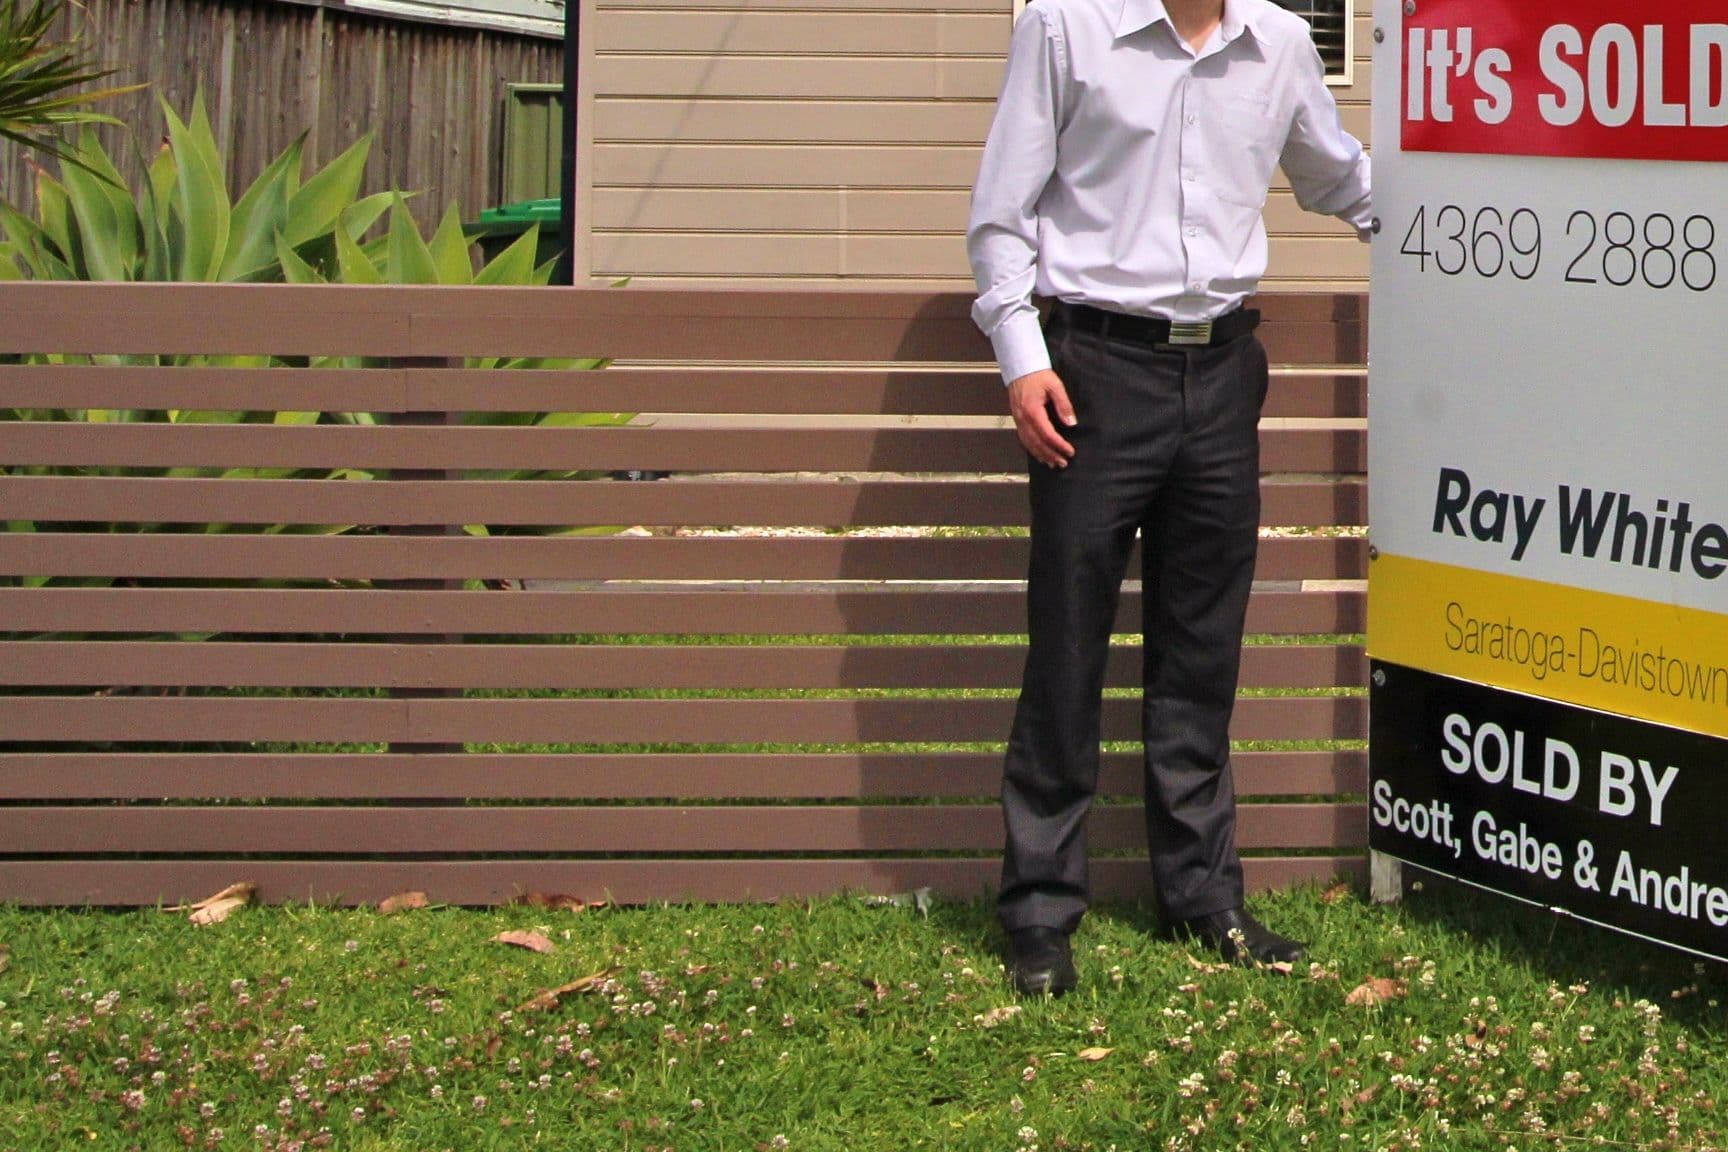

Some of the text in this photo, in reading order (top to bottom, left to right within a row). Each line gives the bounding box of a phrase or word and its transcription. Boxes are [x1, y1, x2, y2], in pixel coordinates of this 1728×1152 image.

[1407, 26, 1514, 125] It's
[1400, 204, 1717, 291] 4369 2888
[1432, 467, 1545, 561] Ray
[1444, 602, 1728, 707] Saratoga-Davistown
[1441, 712, 1680, 826] SOLD BY
[1373, 778, 1462, 857] Scott,
[1471, 809, 1563, 879] Gabe
[1573, 839, 1601, 892] &
